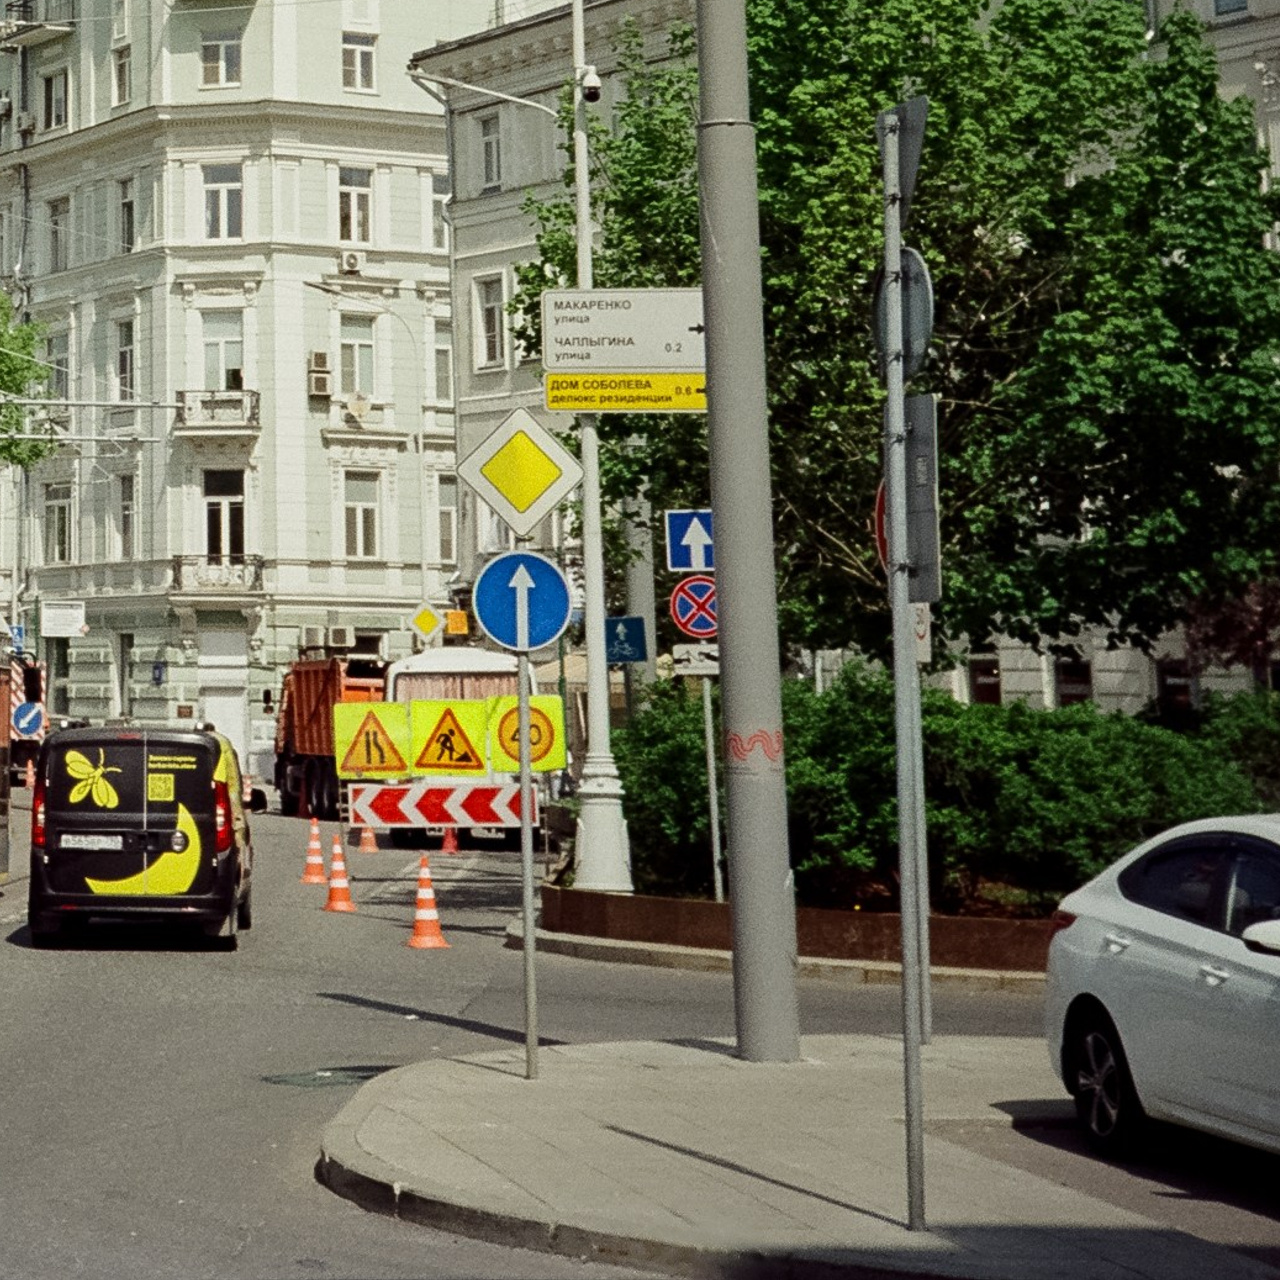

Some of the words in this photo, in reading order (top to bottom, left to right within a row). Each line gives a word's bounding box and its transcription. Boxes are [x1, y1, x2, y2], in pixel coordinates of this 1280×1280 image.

[553, 299, 632, 311] МАКАРЕНКО
[553, 314, 591, 326] улица
[554, 336, 636, 347] ЧАПЛЫГИНА
[554, 351, 592, 362] улица
[550, 379, 580, 392] ДОМ
[582, 379, 653, 391] СОБОЛЕВА
[550, 394, 597, 405] делюкс
